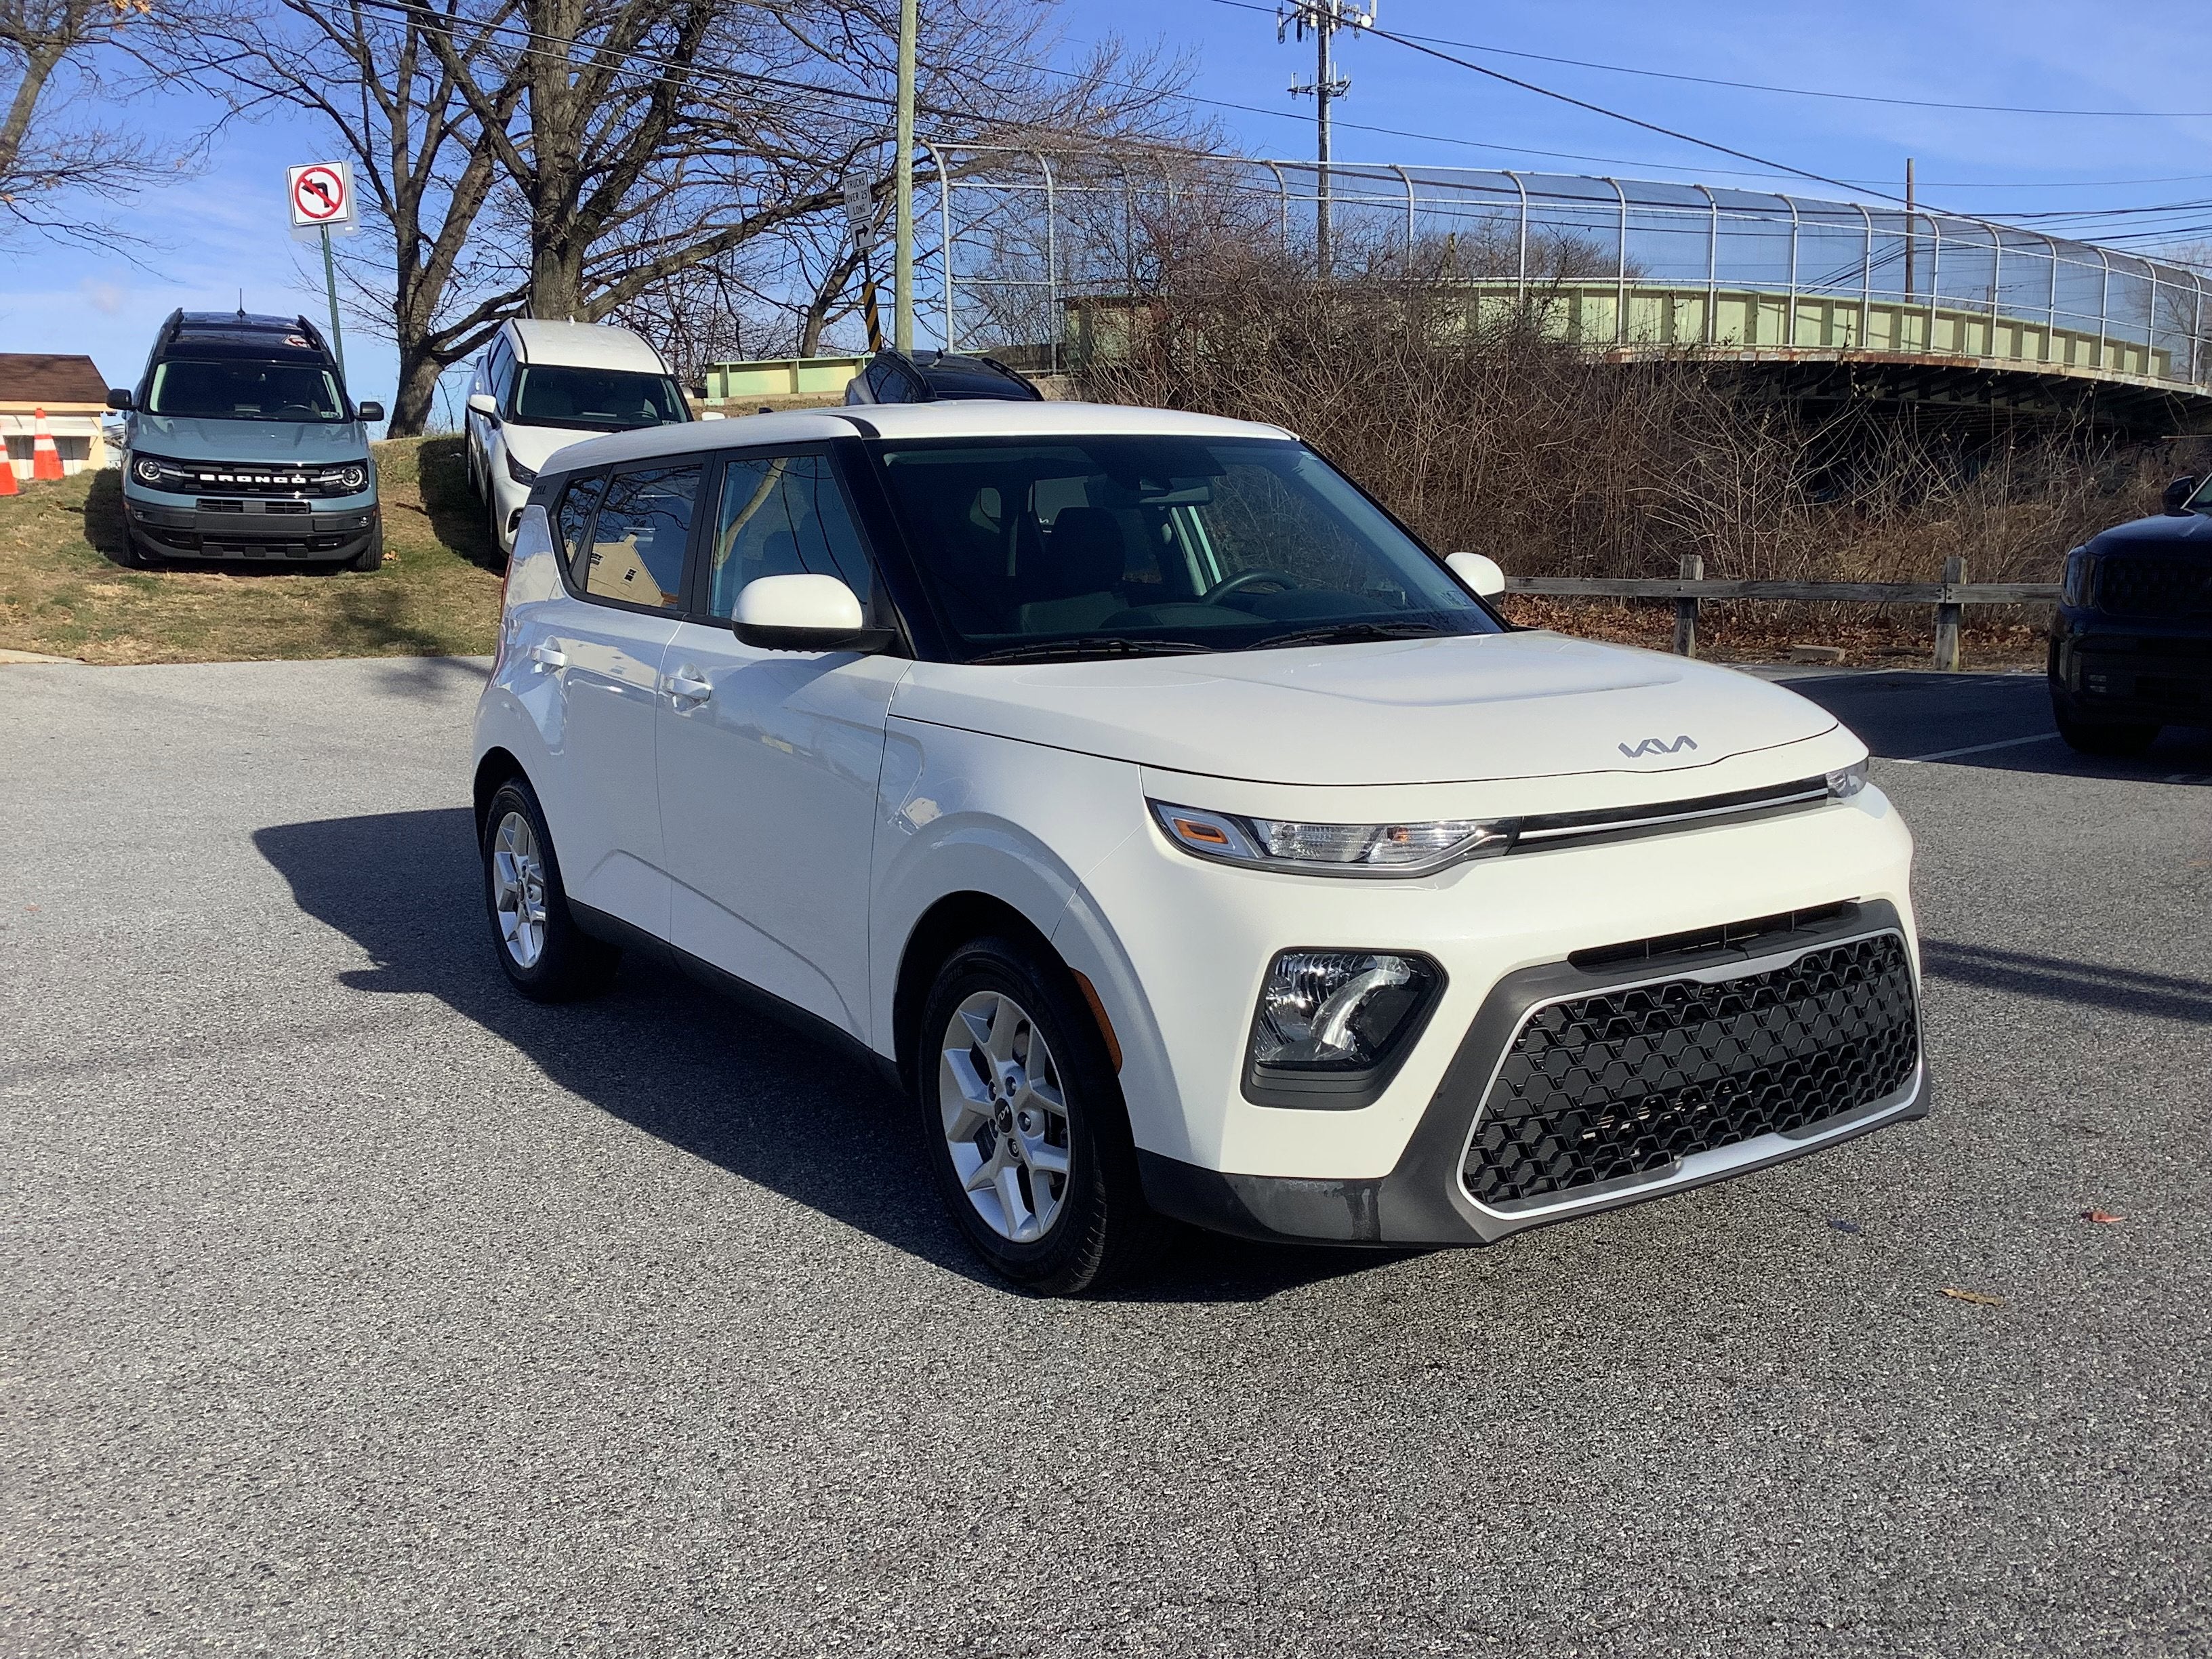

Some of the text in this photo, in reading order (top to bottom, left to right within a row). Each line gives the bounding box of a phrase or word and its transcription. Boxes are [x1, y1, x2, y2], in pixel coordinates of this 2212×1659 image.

[846, 176, 865, 190] TRUCKS
[846, 192, 859, 204] OVER
[853, 204, 865, 215] LONG
[200, 474, 306, 484] BRONCO
[1618, 735, 1698, 758] KIA
